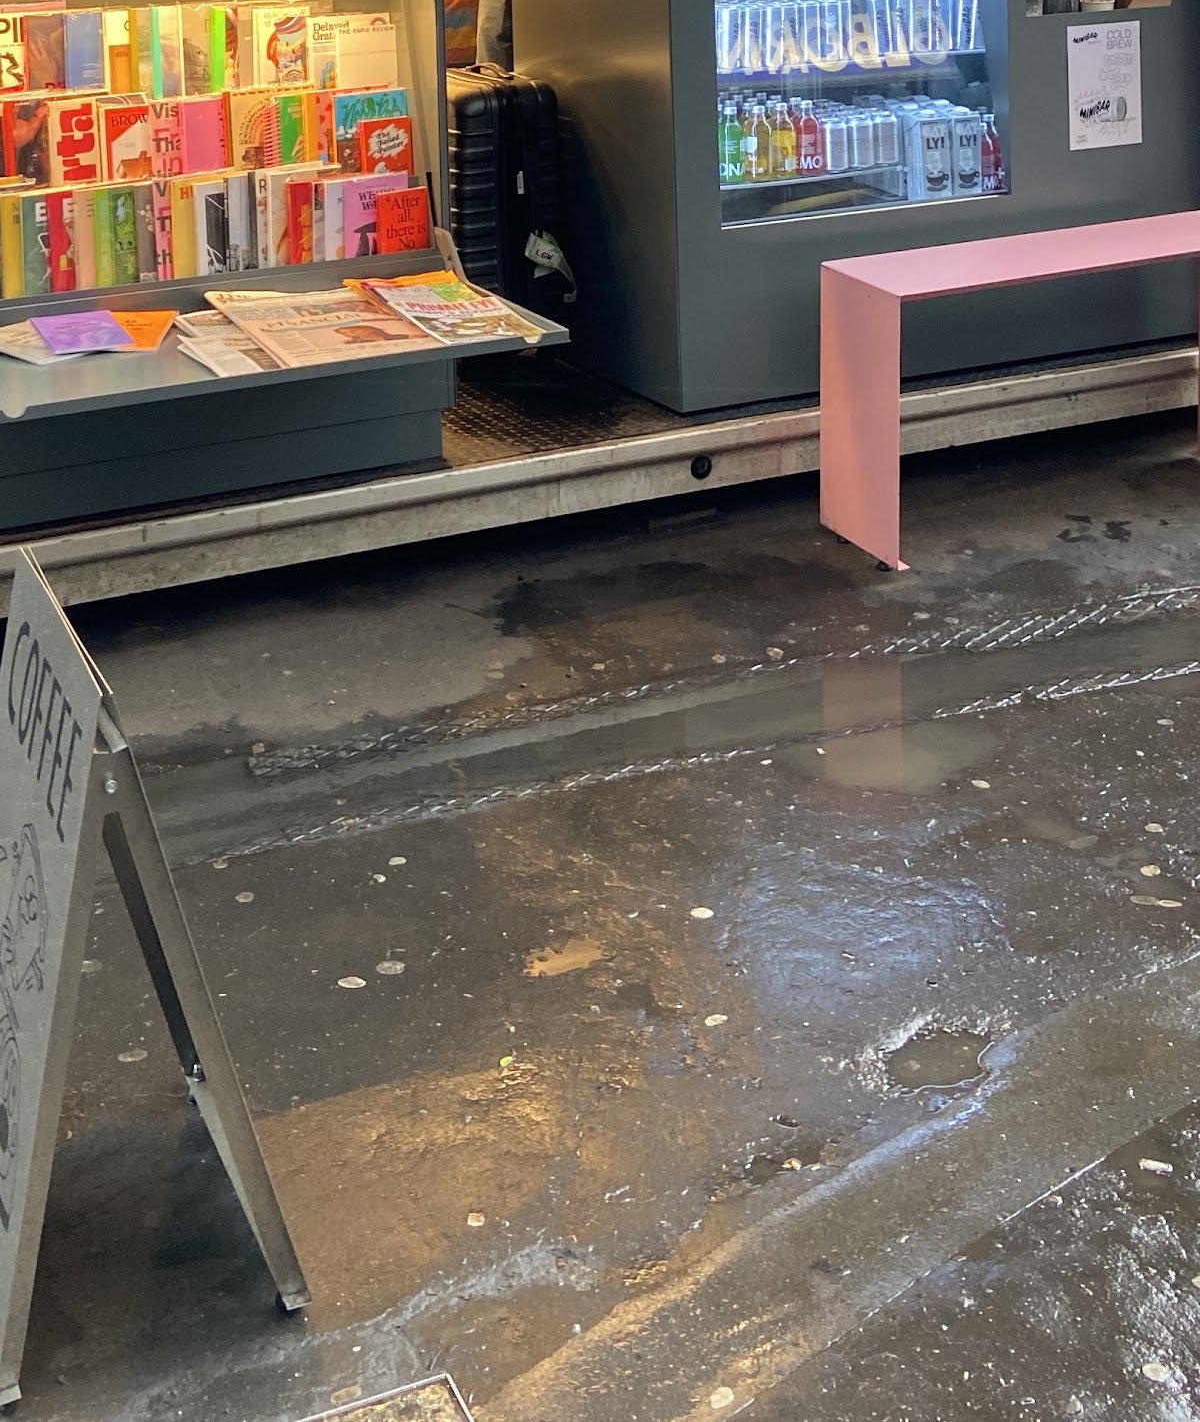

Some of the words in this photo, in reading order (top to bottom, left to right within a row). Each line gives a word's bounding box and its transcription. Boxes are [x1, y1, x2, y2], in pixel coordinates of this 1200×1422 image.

[372, 25, 395, 34] REVIEW
[1106, 29, 1132, 40] COLD
[1072, 32, 1098, 44] MINIBAR
[1106, 39, 1132, 50] BREW
[1079, 99, 1111, 119] MINIBAR
[926, 135, 945, 150] LY!
[959, 133, 977, 147] LY!
[386, 224, 414, 240] there
[417, 220, 426, 234] is
[399, 237, 415, 251] No
[405, 301, 468, 312] PRIVATE
[8, 620, 83, 844] COFFEE
